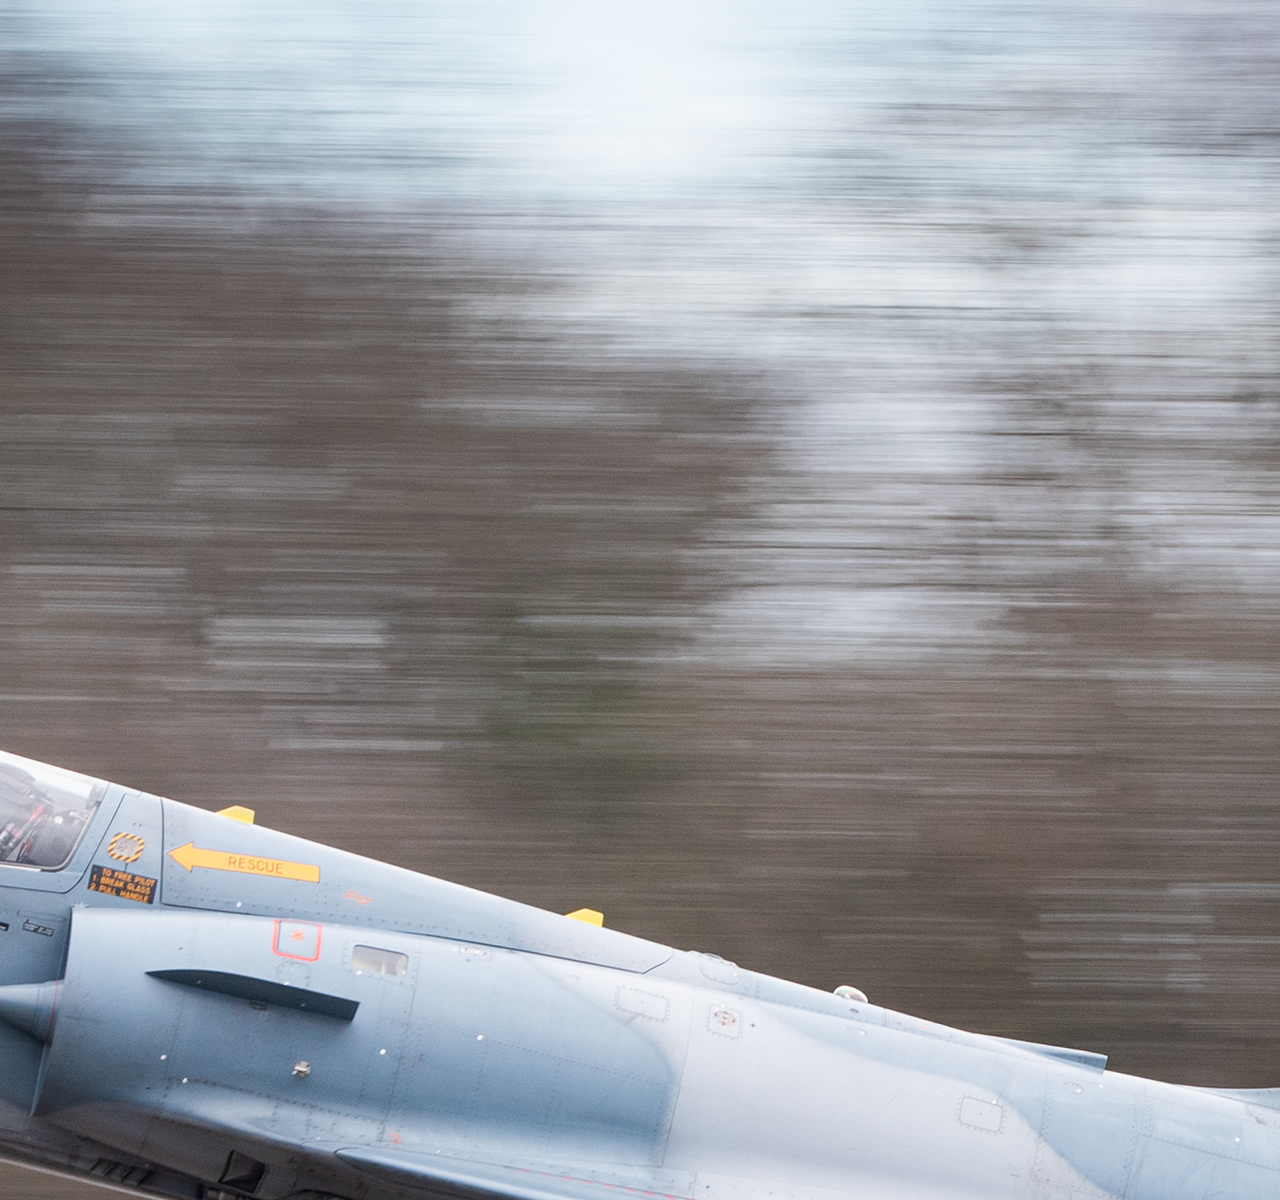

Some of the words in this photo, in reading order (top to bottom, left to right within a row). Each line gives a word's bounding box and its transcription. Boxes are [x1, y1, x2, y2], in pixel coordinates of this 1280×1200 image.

[227, 856, 283, 874] RESCUE
[100, 876, 125, 888] BREAK
[126, 883, 151, 895] GLASS
[102, 868, 112, 877] TO
[114, 871, 133, 882] FREE
[134, 876, 156, 887] PILOT
[98, 885, 117, 896] PULL
[119, 890, 149, 903] HANDLE
